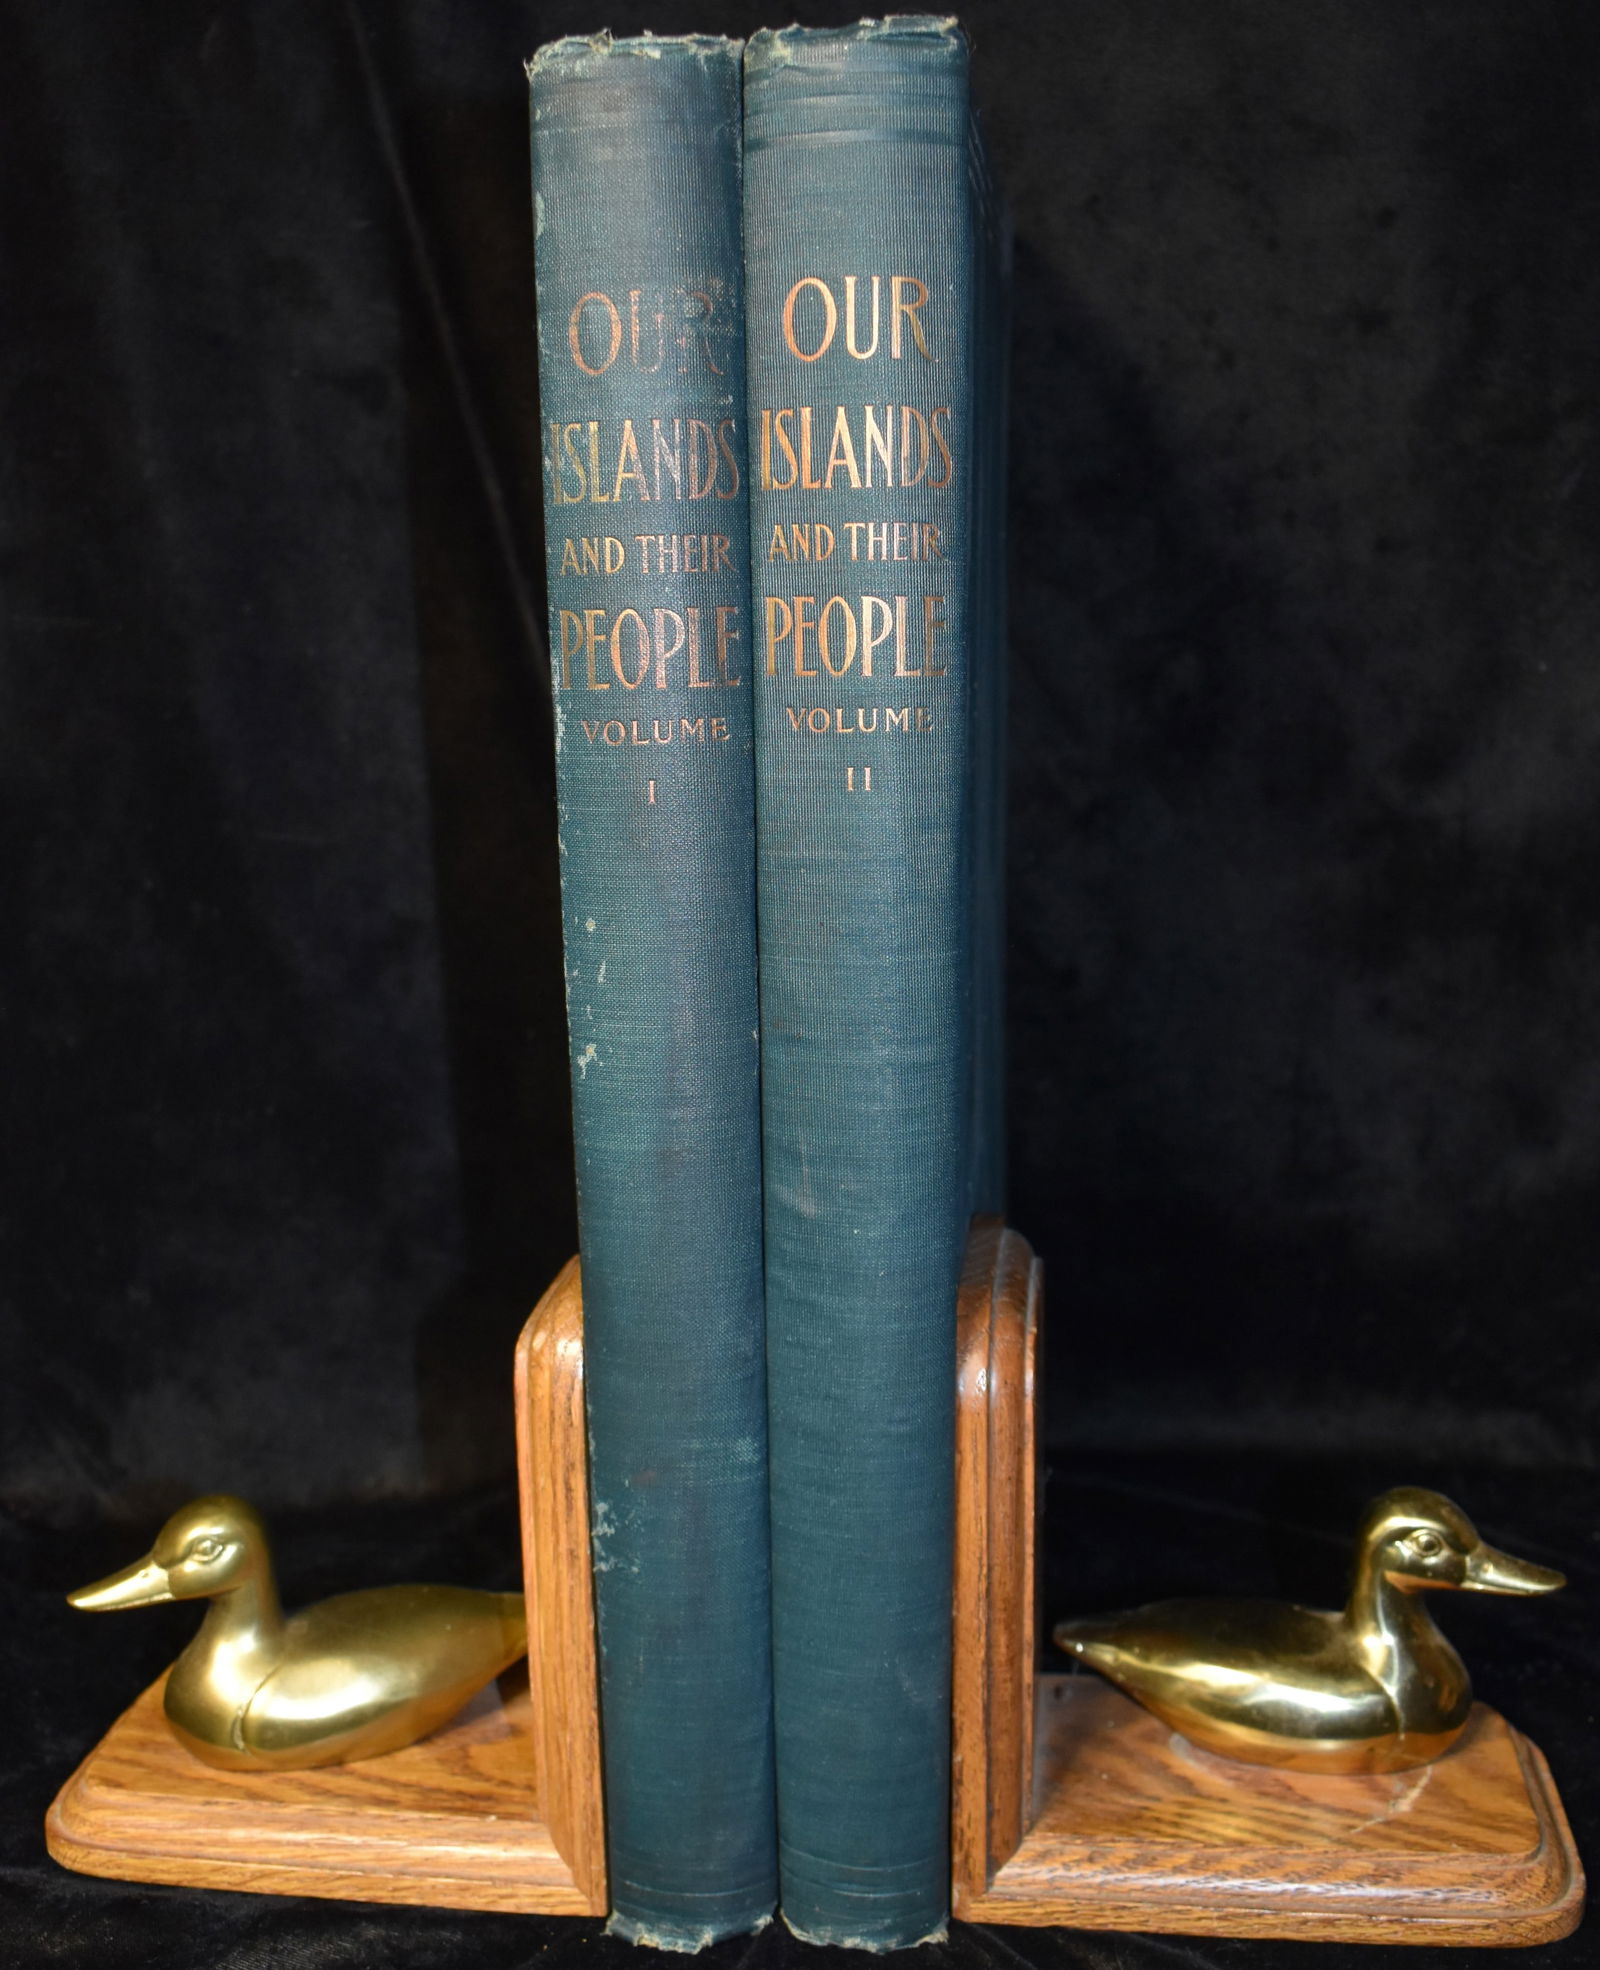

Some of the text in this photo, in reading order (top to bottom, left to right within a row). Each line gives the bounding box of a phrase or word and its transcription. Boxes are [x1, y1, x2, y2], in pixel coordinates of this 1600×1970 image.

[782, 275, 939, 362] OUR
[550, 418, 739, 505] ISLANDS
[760, 404, 953, 491] ISLANDS
[560, 534, 737, 576] AND THEIR
[768, 522, 947, 562] AND THEIR
[559, 606, 740, 690] PEOPLE
[765, 595, 948, 678] PEOPLE
[582, 717, 730, 746] VOLUME
[786, 706, 933, 733] VOLUME
[647, 779, 657, 804] I
[846, 767, 872, 792] II
